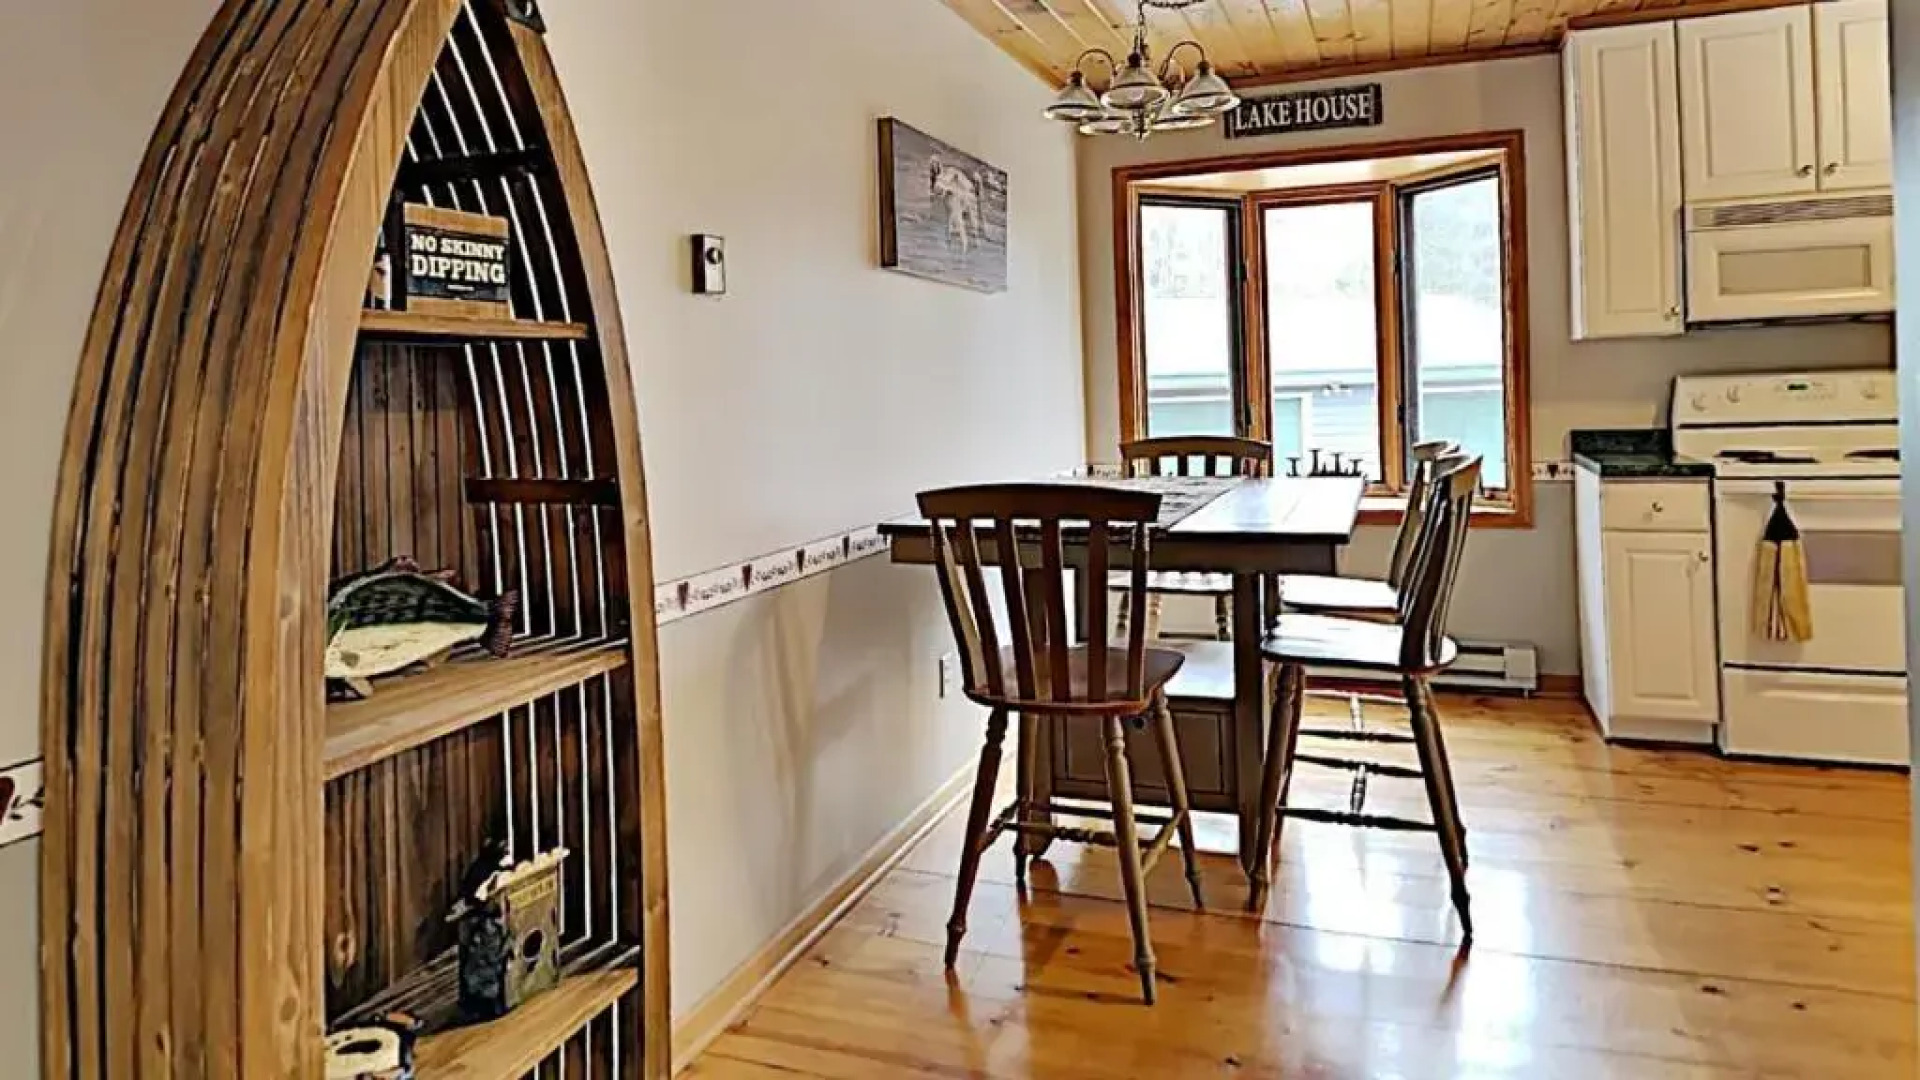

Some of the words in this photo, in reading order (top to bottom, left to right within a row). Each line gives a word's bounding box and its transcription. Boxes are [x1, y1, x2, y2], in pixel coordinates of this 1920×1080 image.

[1235, 101, 1292, 131] LAKE
[1295, 93, 1372, 124] HOUSE
[410, 233, 438, 252] NO
[440, 237, 505, 261] SKINNY
[411, 254, 506, 284] DIPPING
